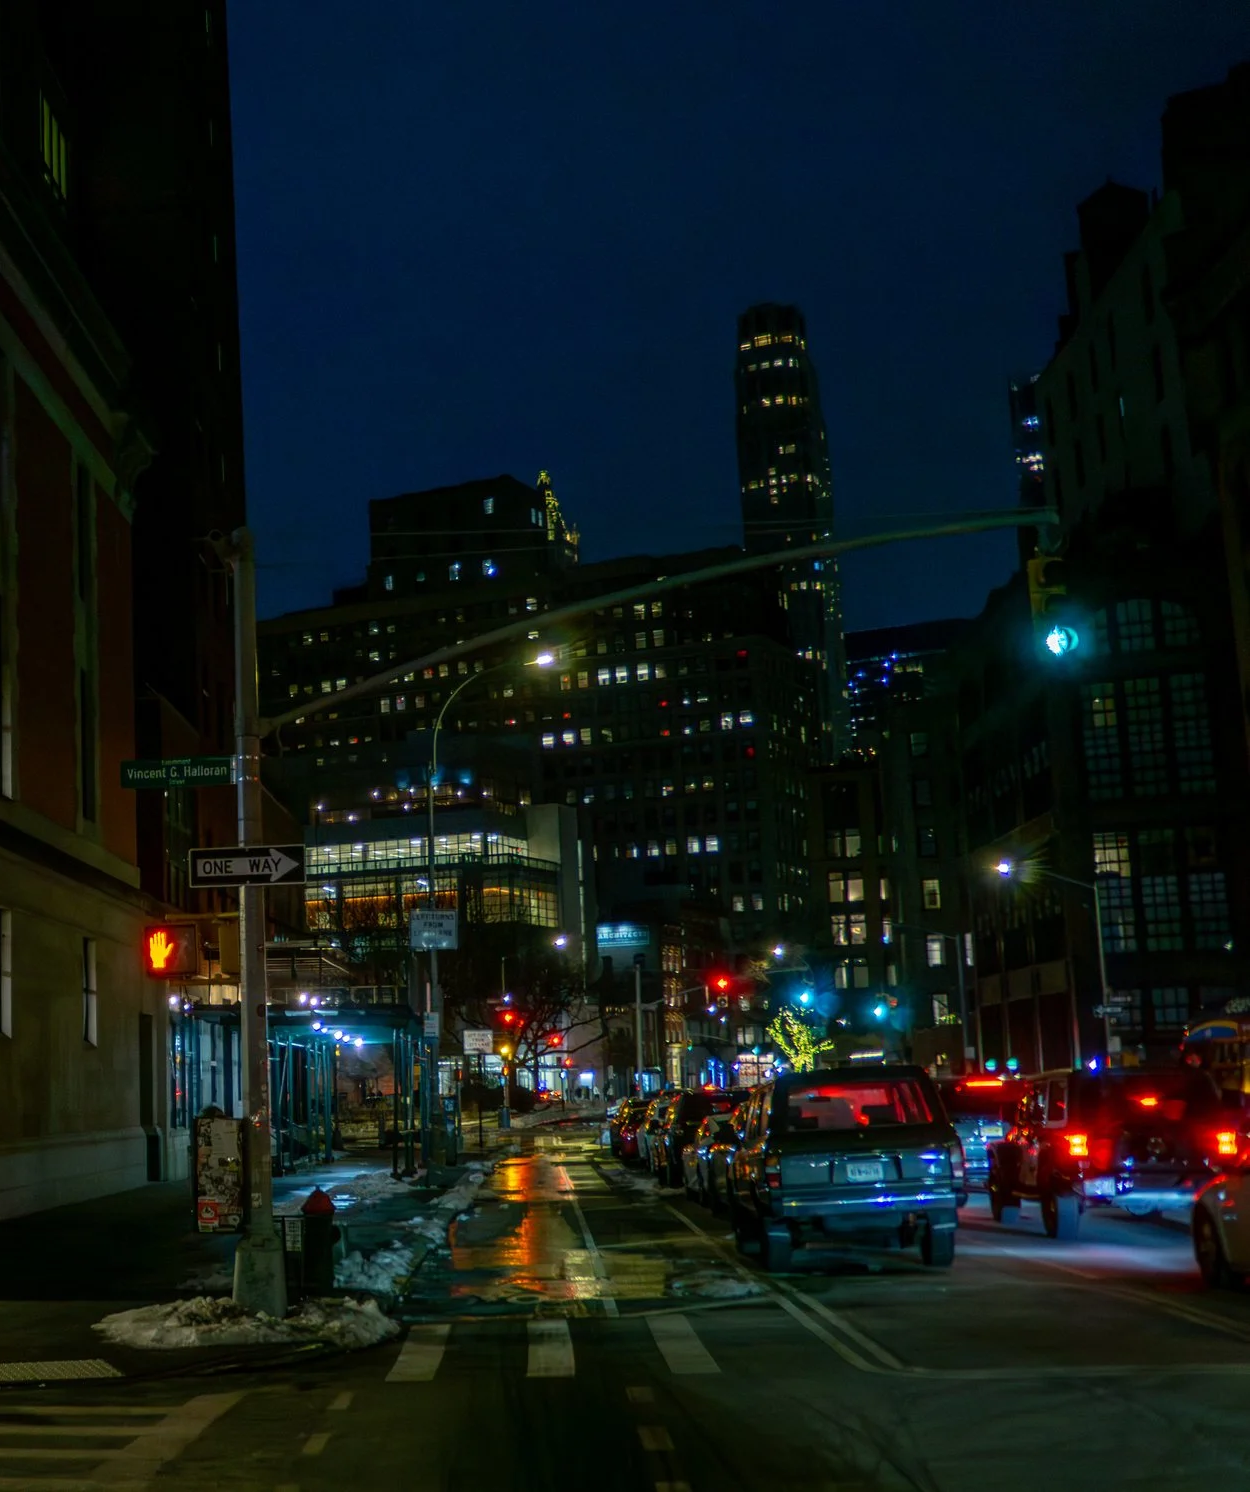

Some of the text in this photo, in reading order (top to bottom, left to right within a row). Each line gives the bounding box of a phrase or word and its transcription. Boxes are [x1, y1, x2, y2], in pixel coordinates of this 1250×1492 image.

[127, 765, 227, 780] Vincent G. Halloran
[202, 857, 281, 875] ONE WAY
